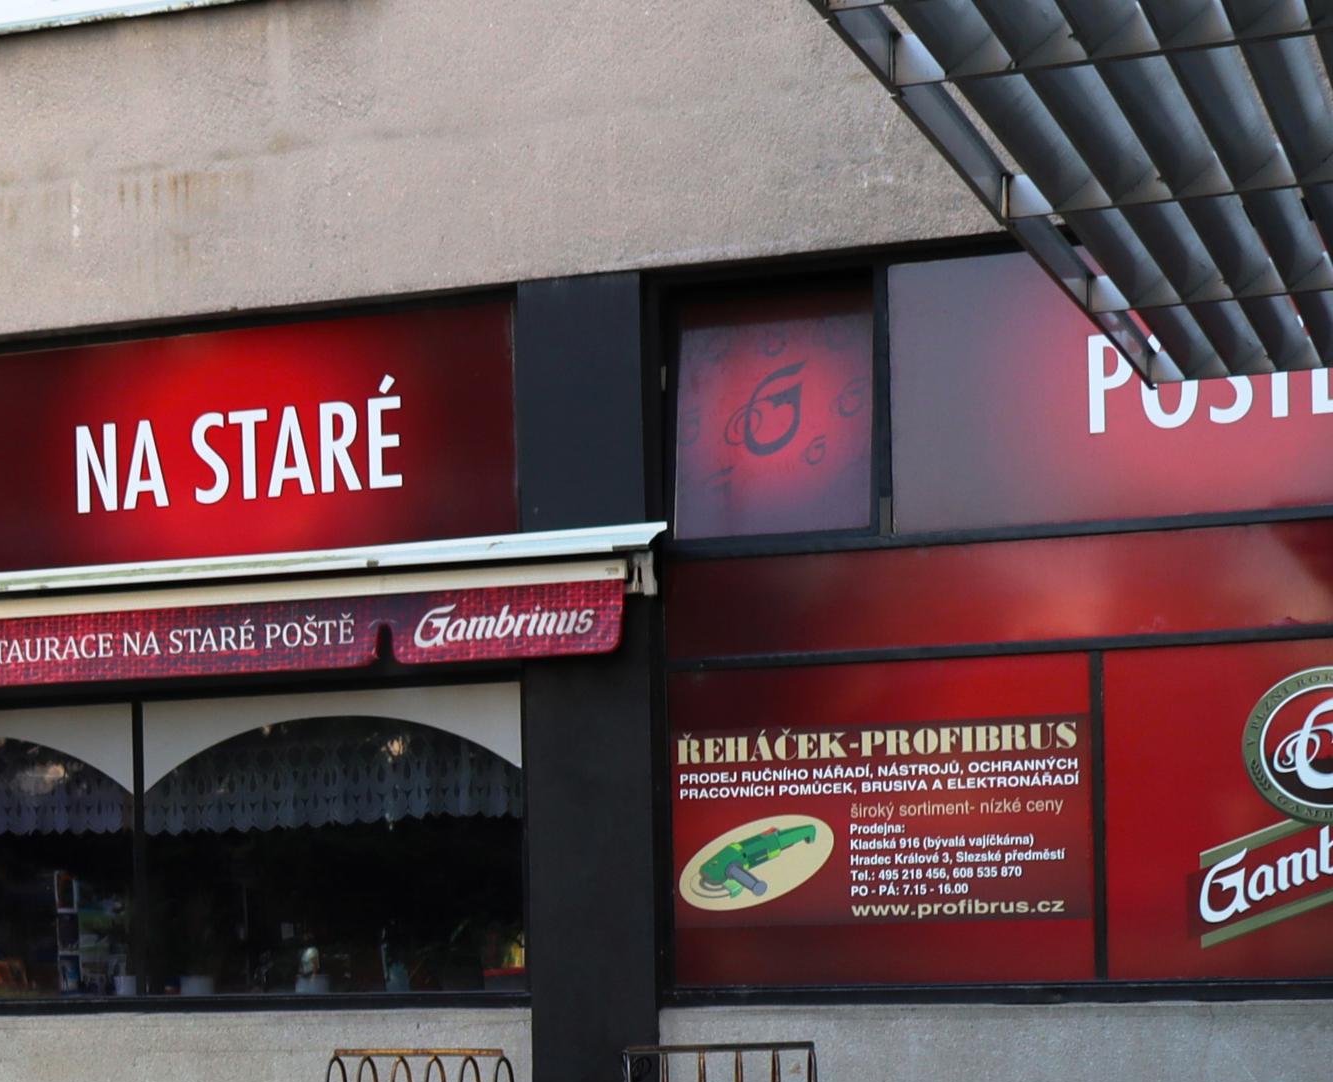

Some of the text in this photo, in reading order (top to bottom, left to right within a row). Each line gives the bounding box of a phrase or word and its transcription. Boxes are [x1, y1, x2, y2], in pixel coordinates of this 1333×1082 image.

[75, 375, 404, 514] NA STARÉ
[122, 631, 161, 657] NA
[168, 620, 256, 655] STARÉ
[264, 613, 355, 648] POŠTĚ
[414, 604, 595, 649] Gambrinus
[677, 721, 1078, 765] ŘEHÁČEK-PROFIBRUS
[679, 756, 1079, 785] PRODEJ RUČNÍHO NÁŘADÍ, NÁSTROJŮ, OCHRANNÝCH
[679, 771, 1080, 800] PRACOVNÍCH POMŮCEK, BRUSIVA A ELEKTRONÁŘADÍ
[850, 802, 894, 821] široký
[980, 797, 1021, 814] nízké
[1026, 799, 1064, 815] ceny
[849, 823, 906, 837] Prodejna:
[850, 833, 1035, 851] Kladská 916 (bývalá vajíčkárna)
[850, 848, 1066, 866] Hradec Králové 3, Slezské předměstí
[850, 865, 1022, 881] Tel.: 495 218 456, 608 535 870
[851, 885, 869, 897] PO
[879, 882, 900, 896] PÁ:
[902, 884, 927, 896] 7.15
[938, 883, 969, 895] 16.00
[851, 899, 1066, 919] www.profibrus.cz
